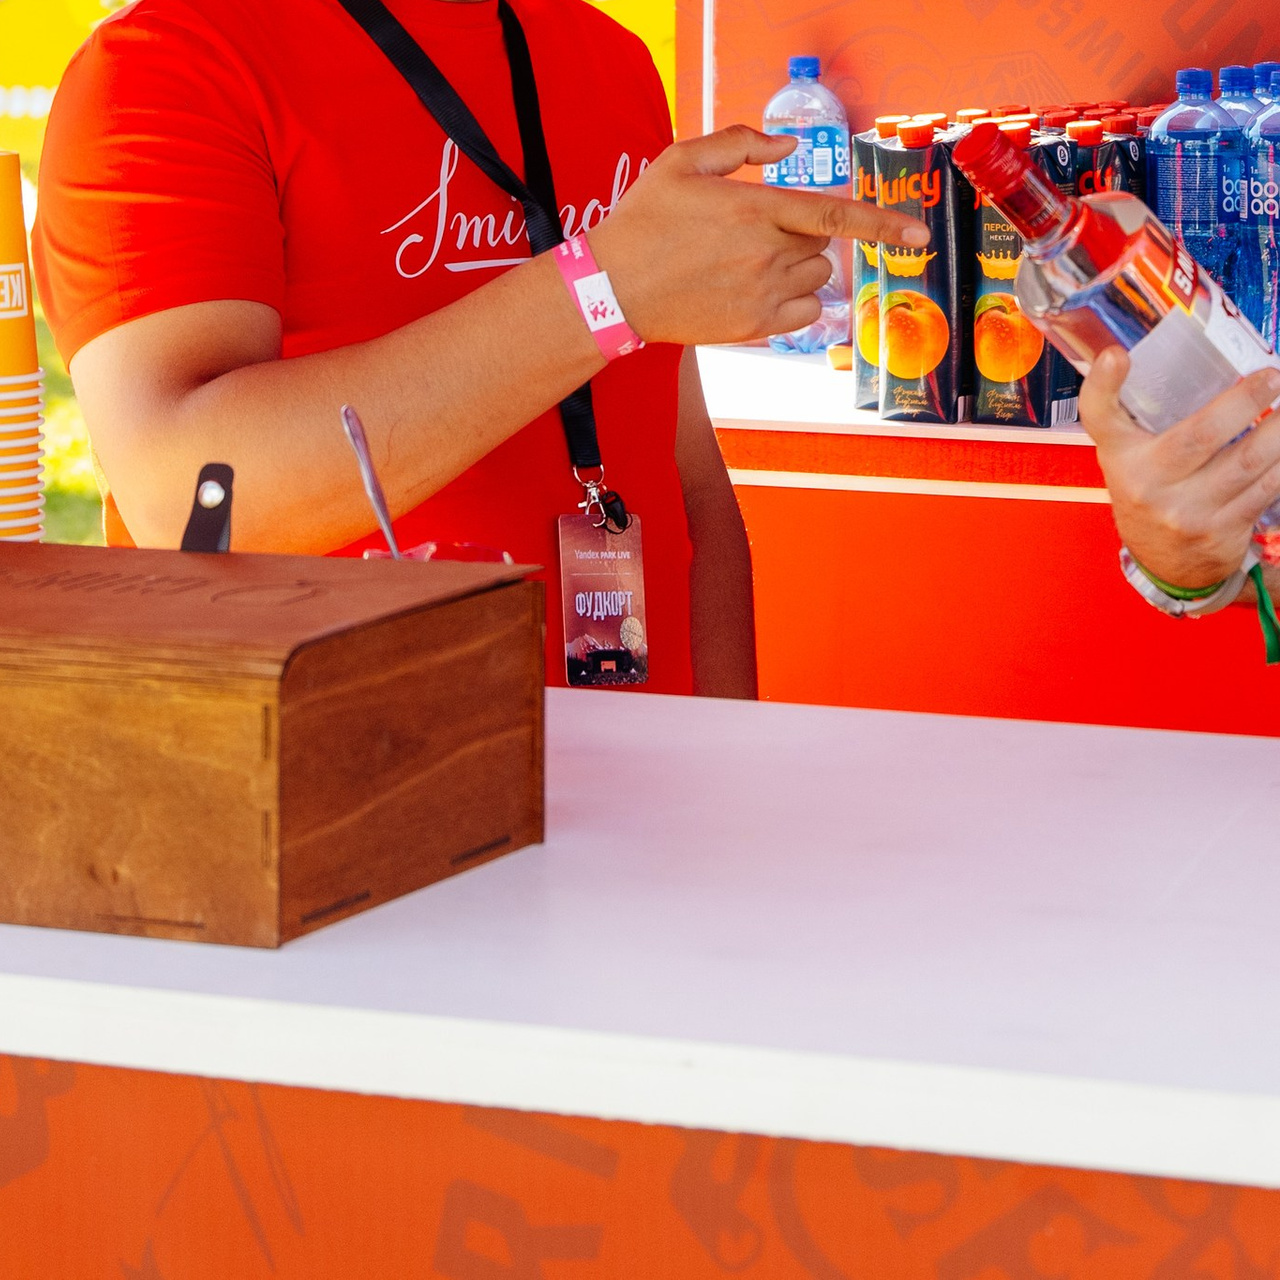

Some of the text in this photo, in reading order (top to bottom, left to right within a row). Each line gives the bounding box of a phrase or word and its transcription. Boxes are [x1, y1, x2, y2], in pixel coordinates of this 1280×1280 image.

[876, 168, 941, 208] Juicy
[380, 137, 650, 278] Sminof
[984, 223, 1017, 232] ПЕРСИ
[574, 550, 600, 560] Yandex
[617, 551, 631, 559] LIVE
[575, 591, 633, 622] ФУДКОРТ
